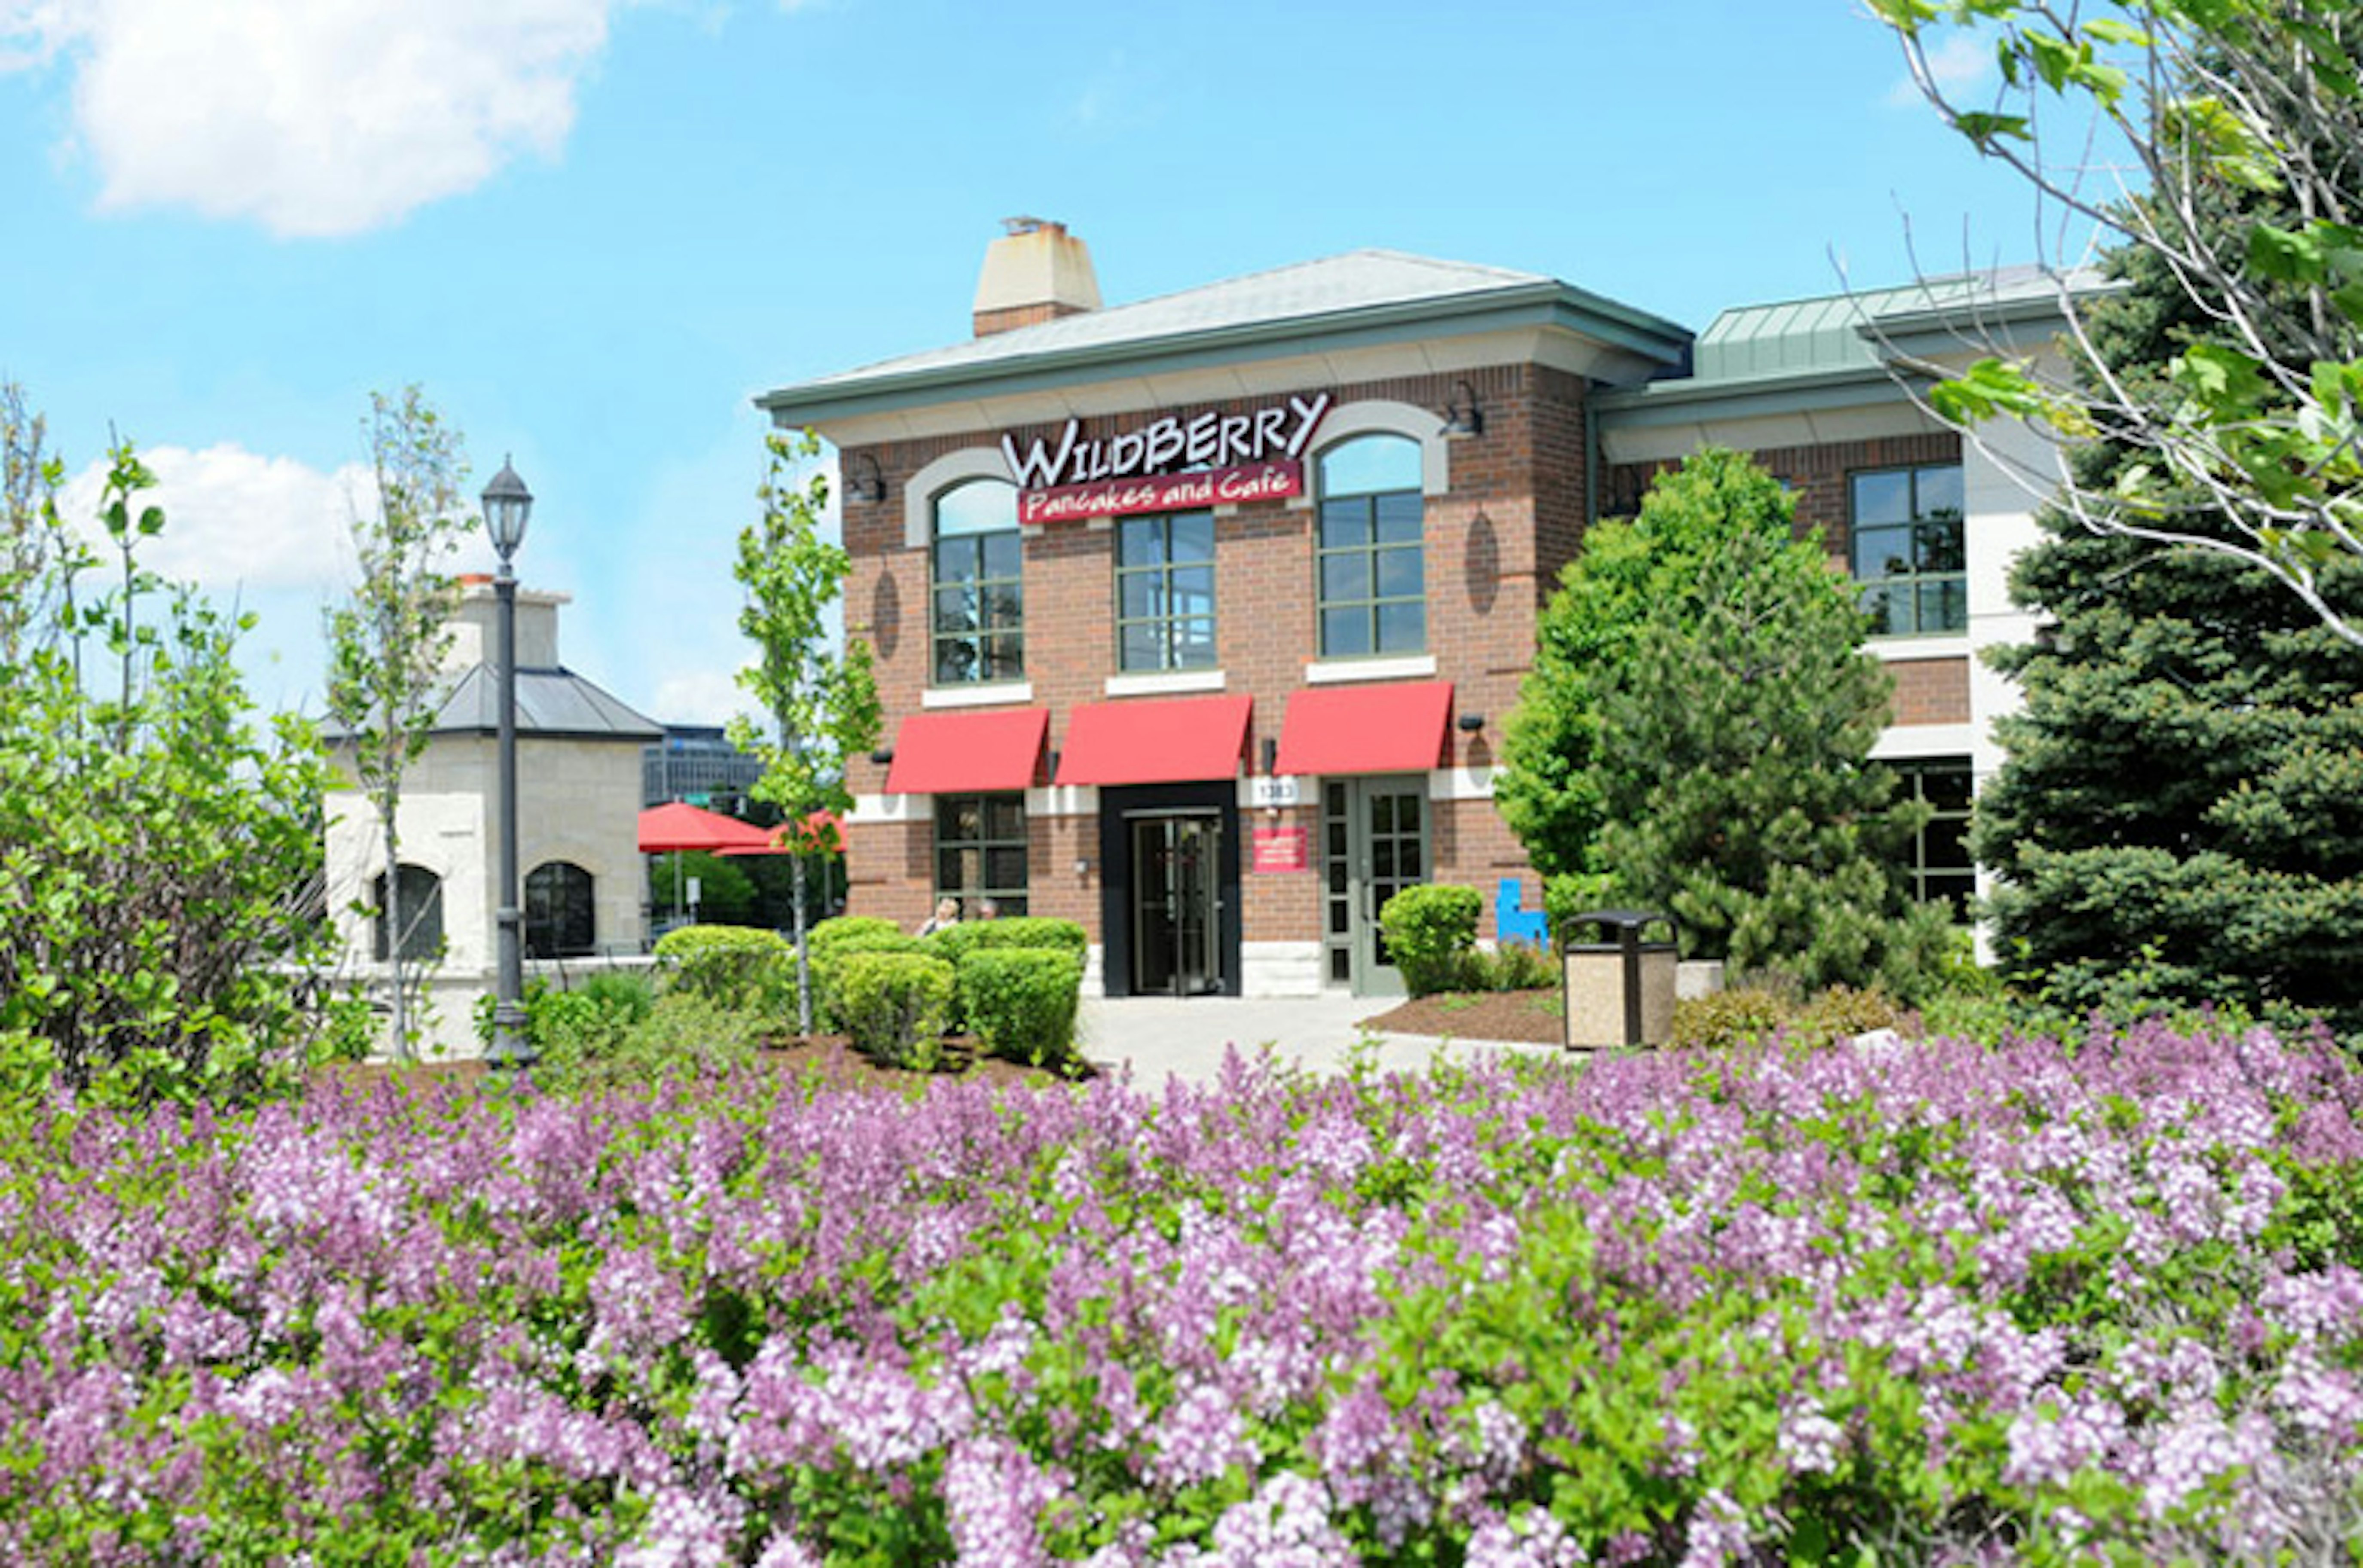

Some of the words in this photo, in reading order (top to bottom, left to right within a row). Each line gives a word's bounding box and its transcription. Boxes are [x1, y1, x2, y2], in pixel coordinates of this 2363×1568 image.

[1001, 392, 1329, 488] WILDBERRY
[1026, 481, 1156, 520] Pancakes
[1162, 473, 1212, 505] and
